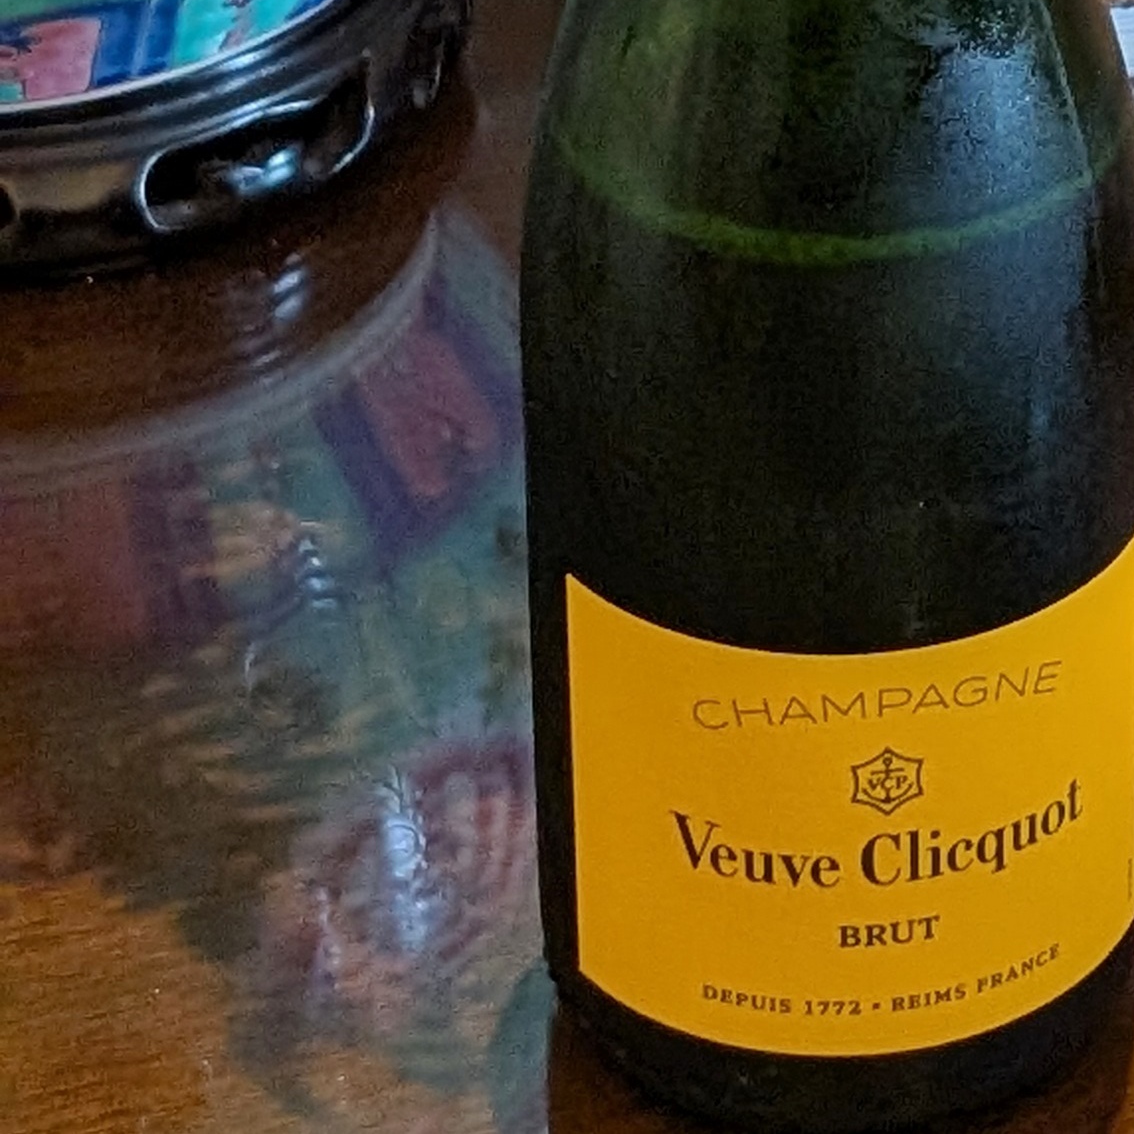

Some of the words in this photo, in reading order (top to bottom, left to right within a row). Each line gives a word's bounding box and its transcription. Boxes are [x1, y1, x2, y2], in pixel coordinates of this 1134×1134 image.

[692, 660, 1062, 731] CHAMPAGNE
[669, 810, 841, 888] Veuve
[860, 778, 1083, 886] Clicquot
[838, 915, 941, 949] BRUT
[702, 984, 792, 1014] DEPUIS
[804, 1000, 862, 1016] 1772
[891, 982, 967, 1012] REIMS
[976, 942, 1061, 994] FRANCE
